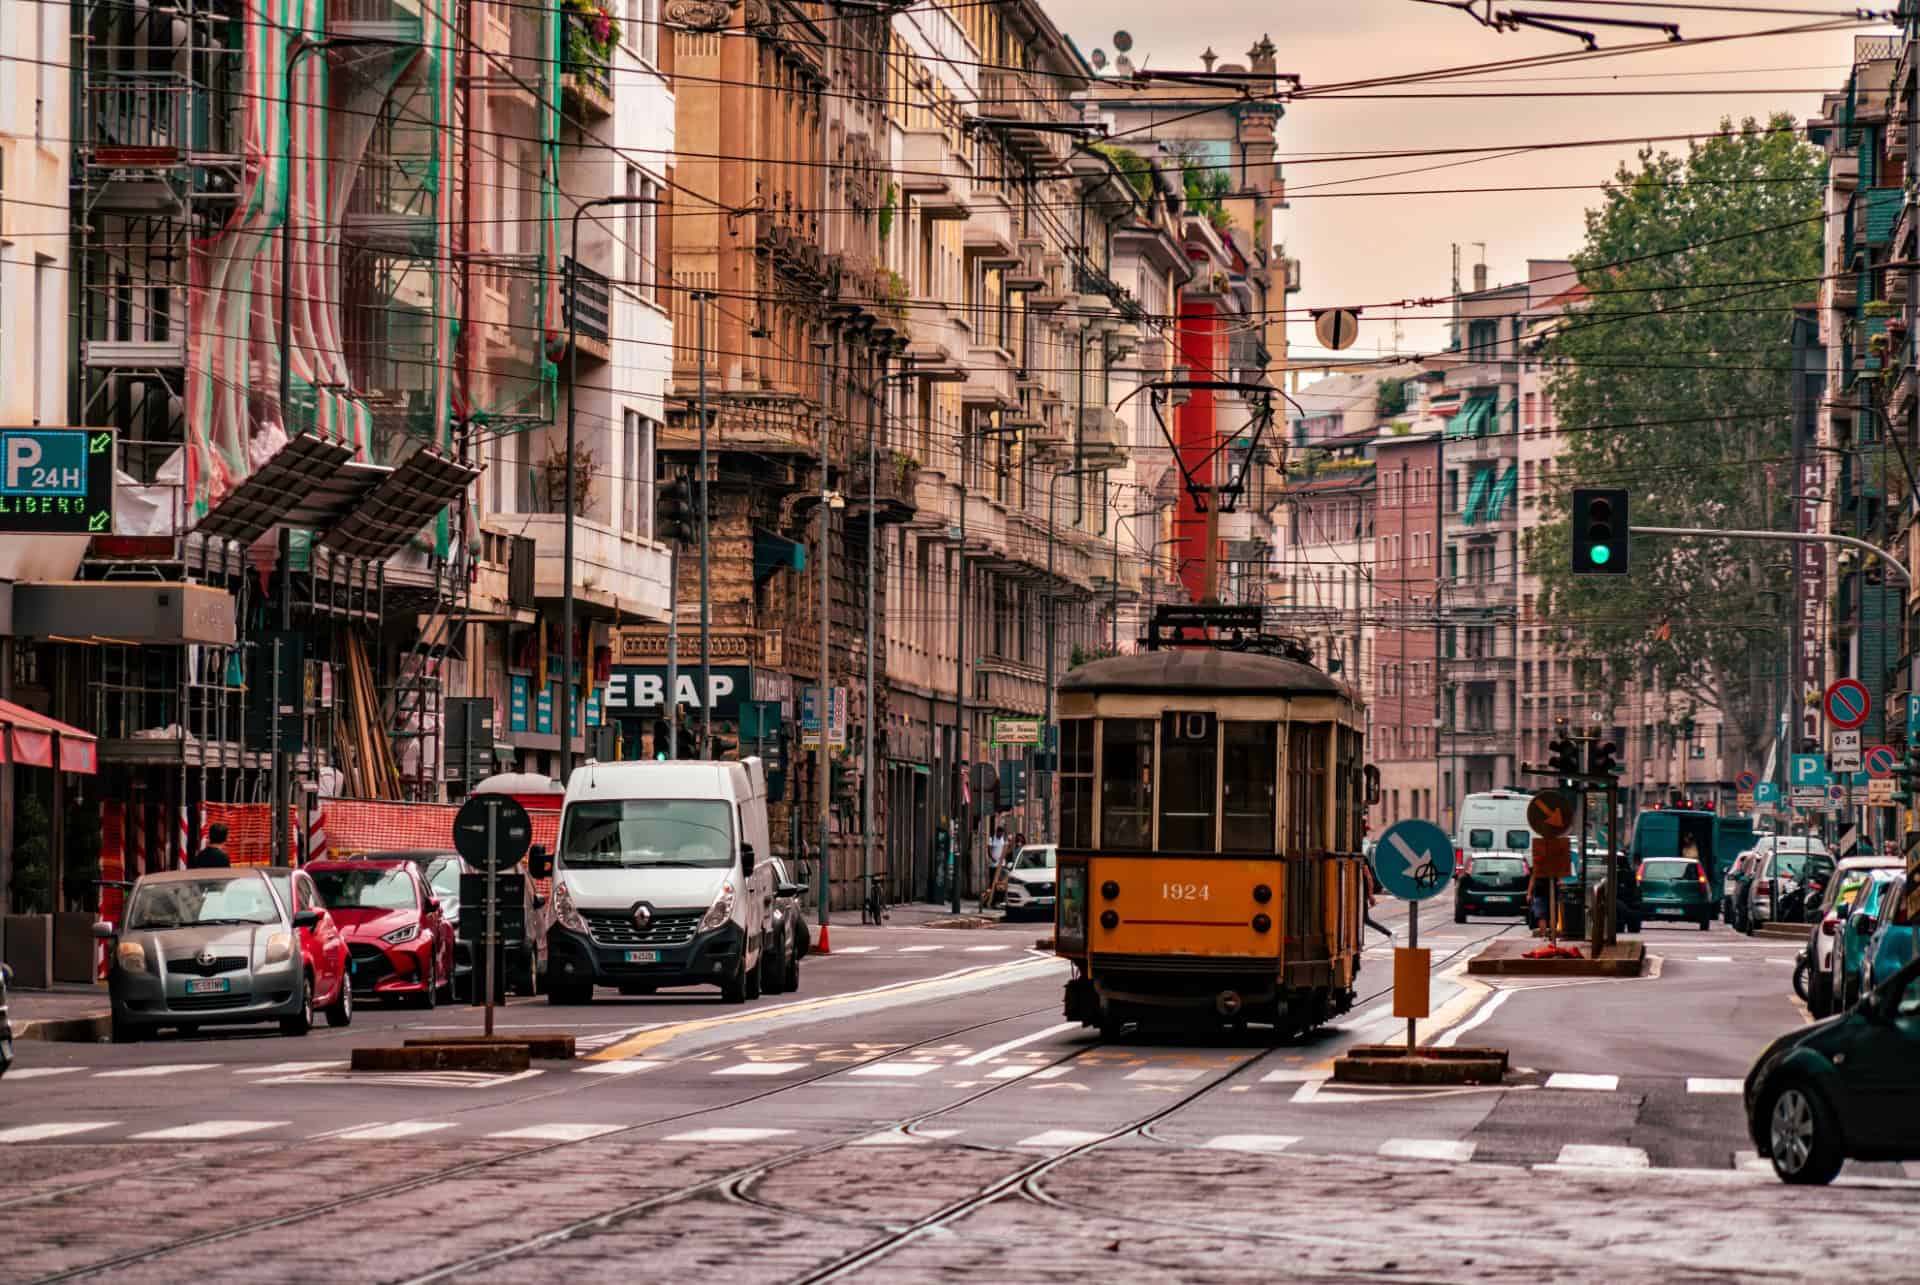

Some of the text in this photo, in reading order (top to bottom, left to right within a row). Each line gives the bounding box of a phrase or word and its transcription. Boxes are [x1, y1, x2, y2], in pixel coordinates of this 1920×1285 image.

[7, 437, 80, 488] P 24H
[0, 496, 86, 514] LIBERO
[1175, 711, 1207, 739] 10
[1797, 757, 1818, 782] P
[1757, 785, 1770, 800] P
[1162, 882, 1211, 902] 1924
